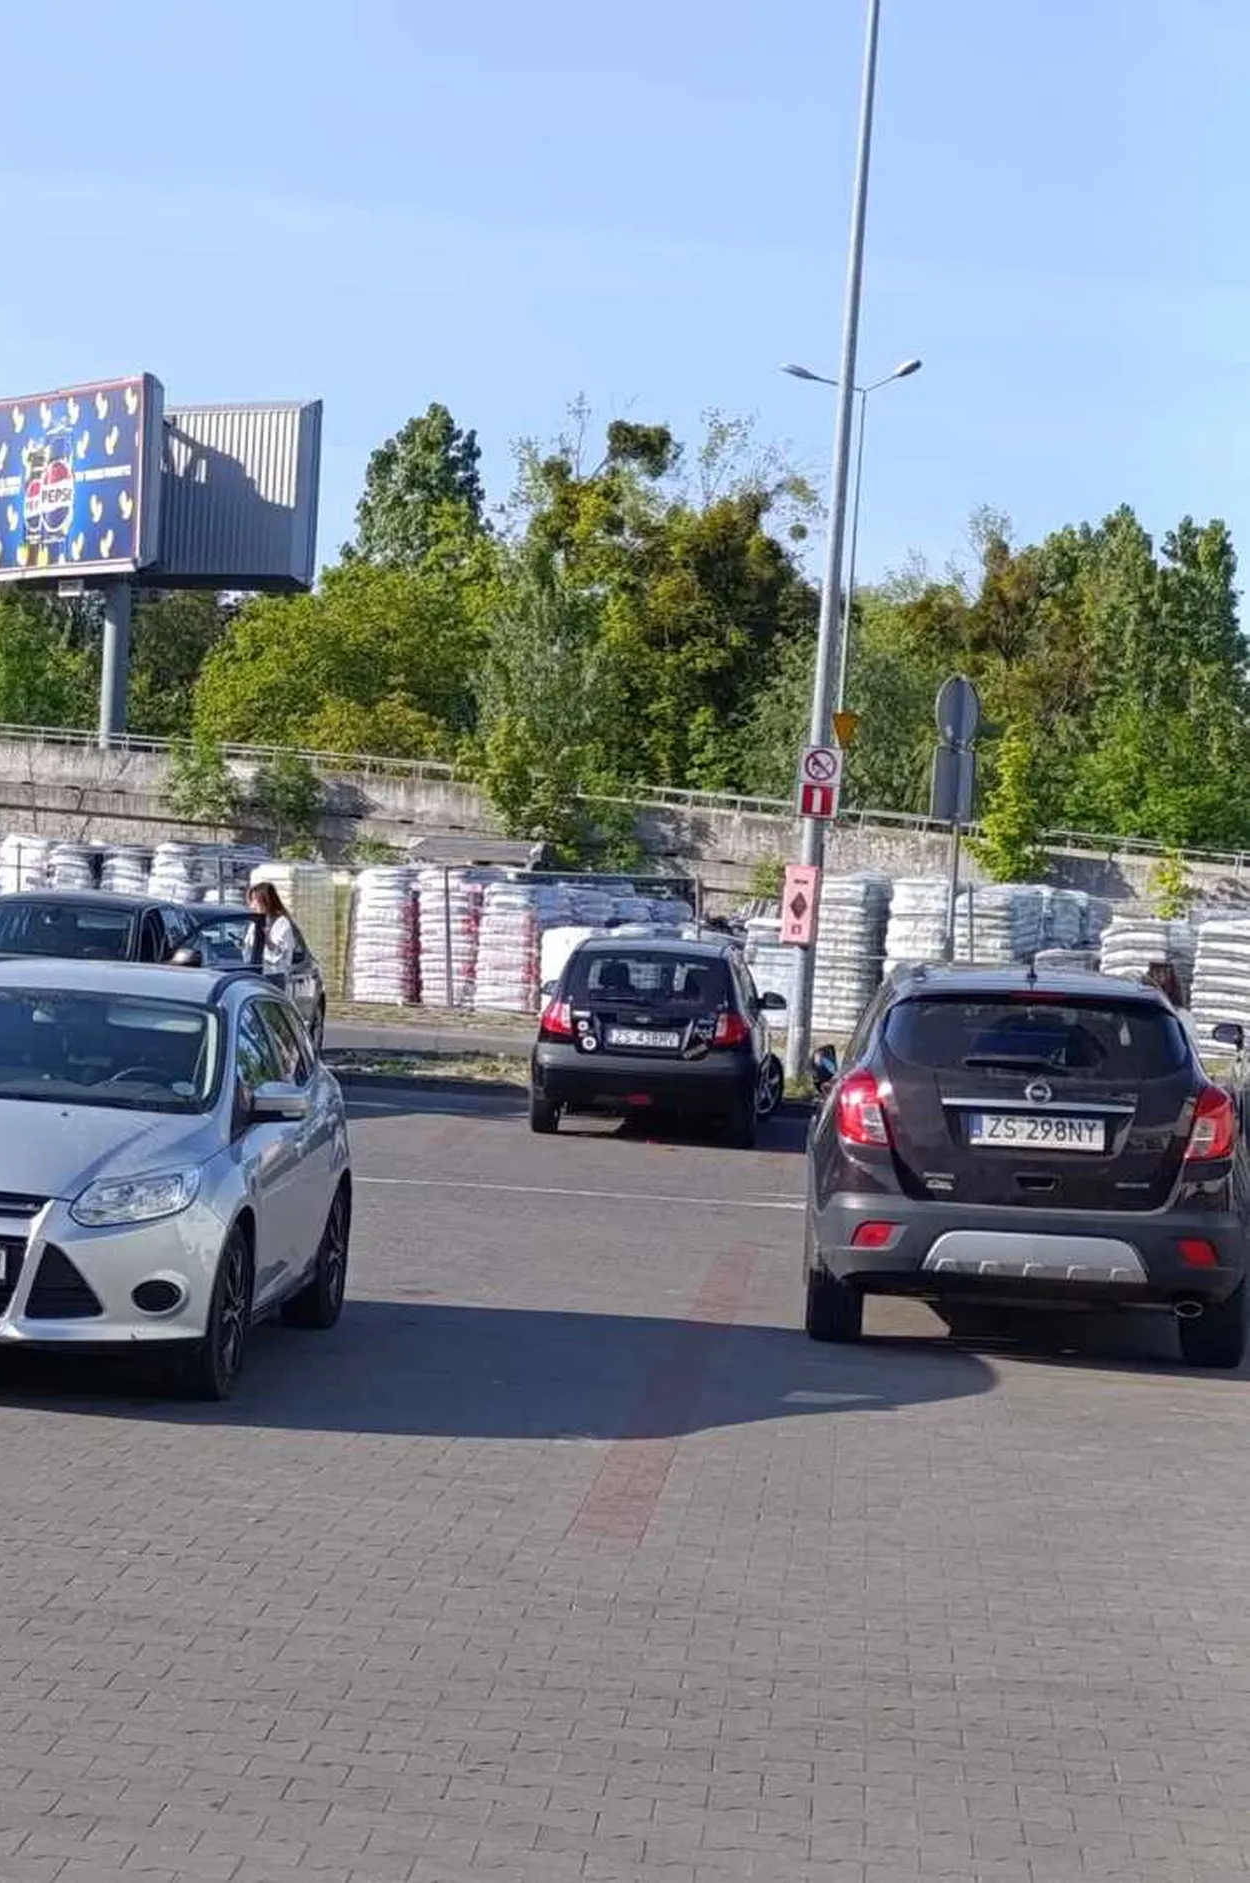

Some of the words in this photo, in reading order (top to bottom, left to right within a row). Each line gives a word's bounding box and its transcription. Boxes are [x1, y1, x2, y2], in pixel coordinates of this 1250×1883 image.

[41, 487, 72, 503] PEPSI
[987, 1117, 1017, 1140] ZS
[1026, 1119, 1097, 1143] 298NY
